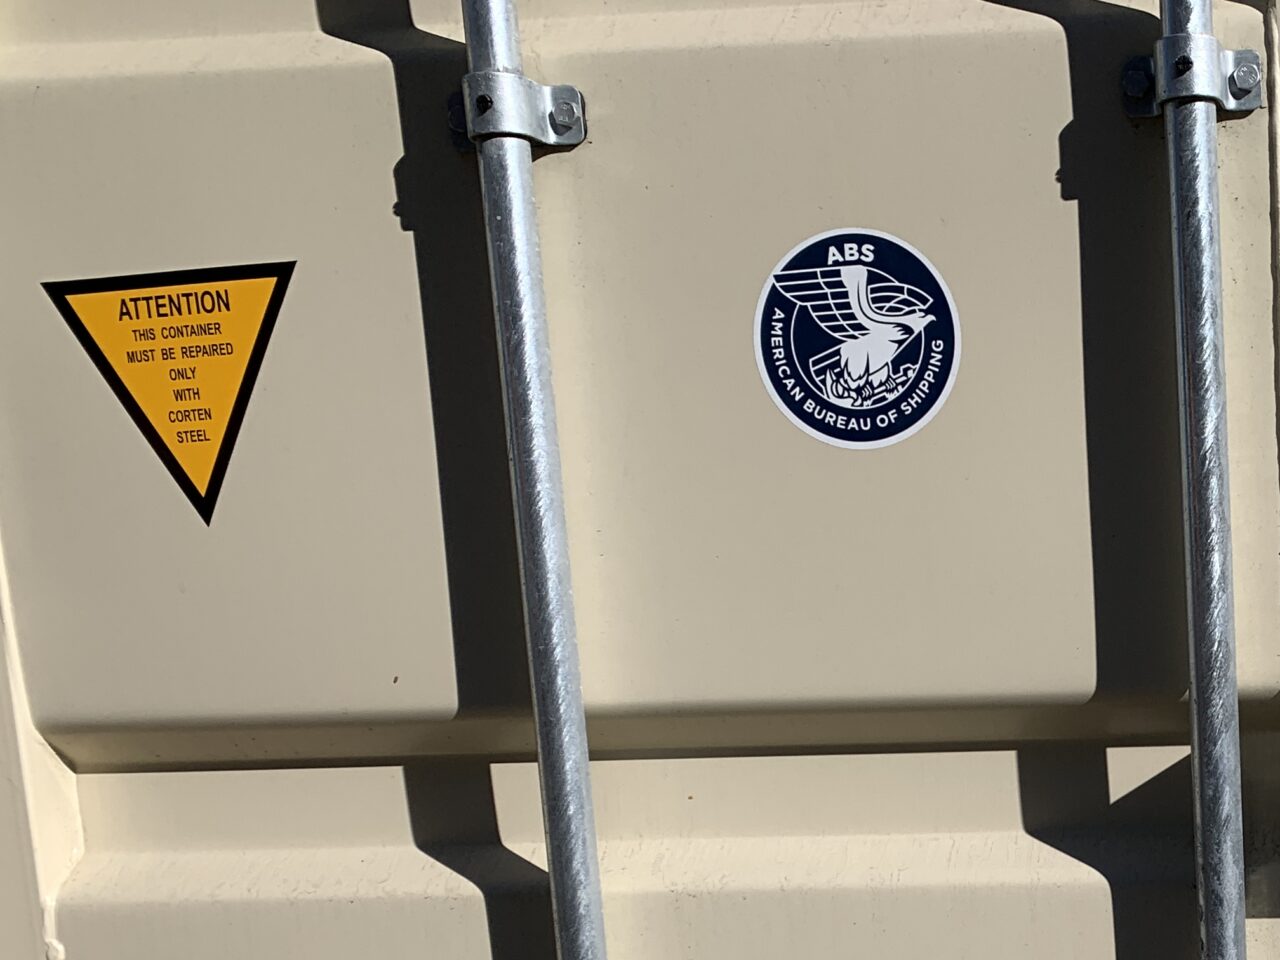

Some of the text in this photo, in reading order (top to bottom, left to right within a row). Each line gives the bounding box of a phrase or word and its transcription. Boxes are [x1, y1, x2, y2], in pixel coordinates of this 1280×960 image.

[827, 242, 875, 265] ABS
[118, 289, 231, 321] ATTENTION
[132, 322, 222, 342] THIS CONTAINER
[127, 342, 234, 363] MUST BE REPAIRED
[169, 367, 197, 381] ONLY
[770, 307, 944, 431] AMERICAN BUREAU OF SHIPPING
[172, 388, 201, 402] WITH
[168, 408, 212, 423] CORTEN
[176, 430, 211, 444] STEEL
